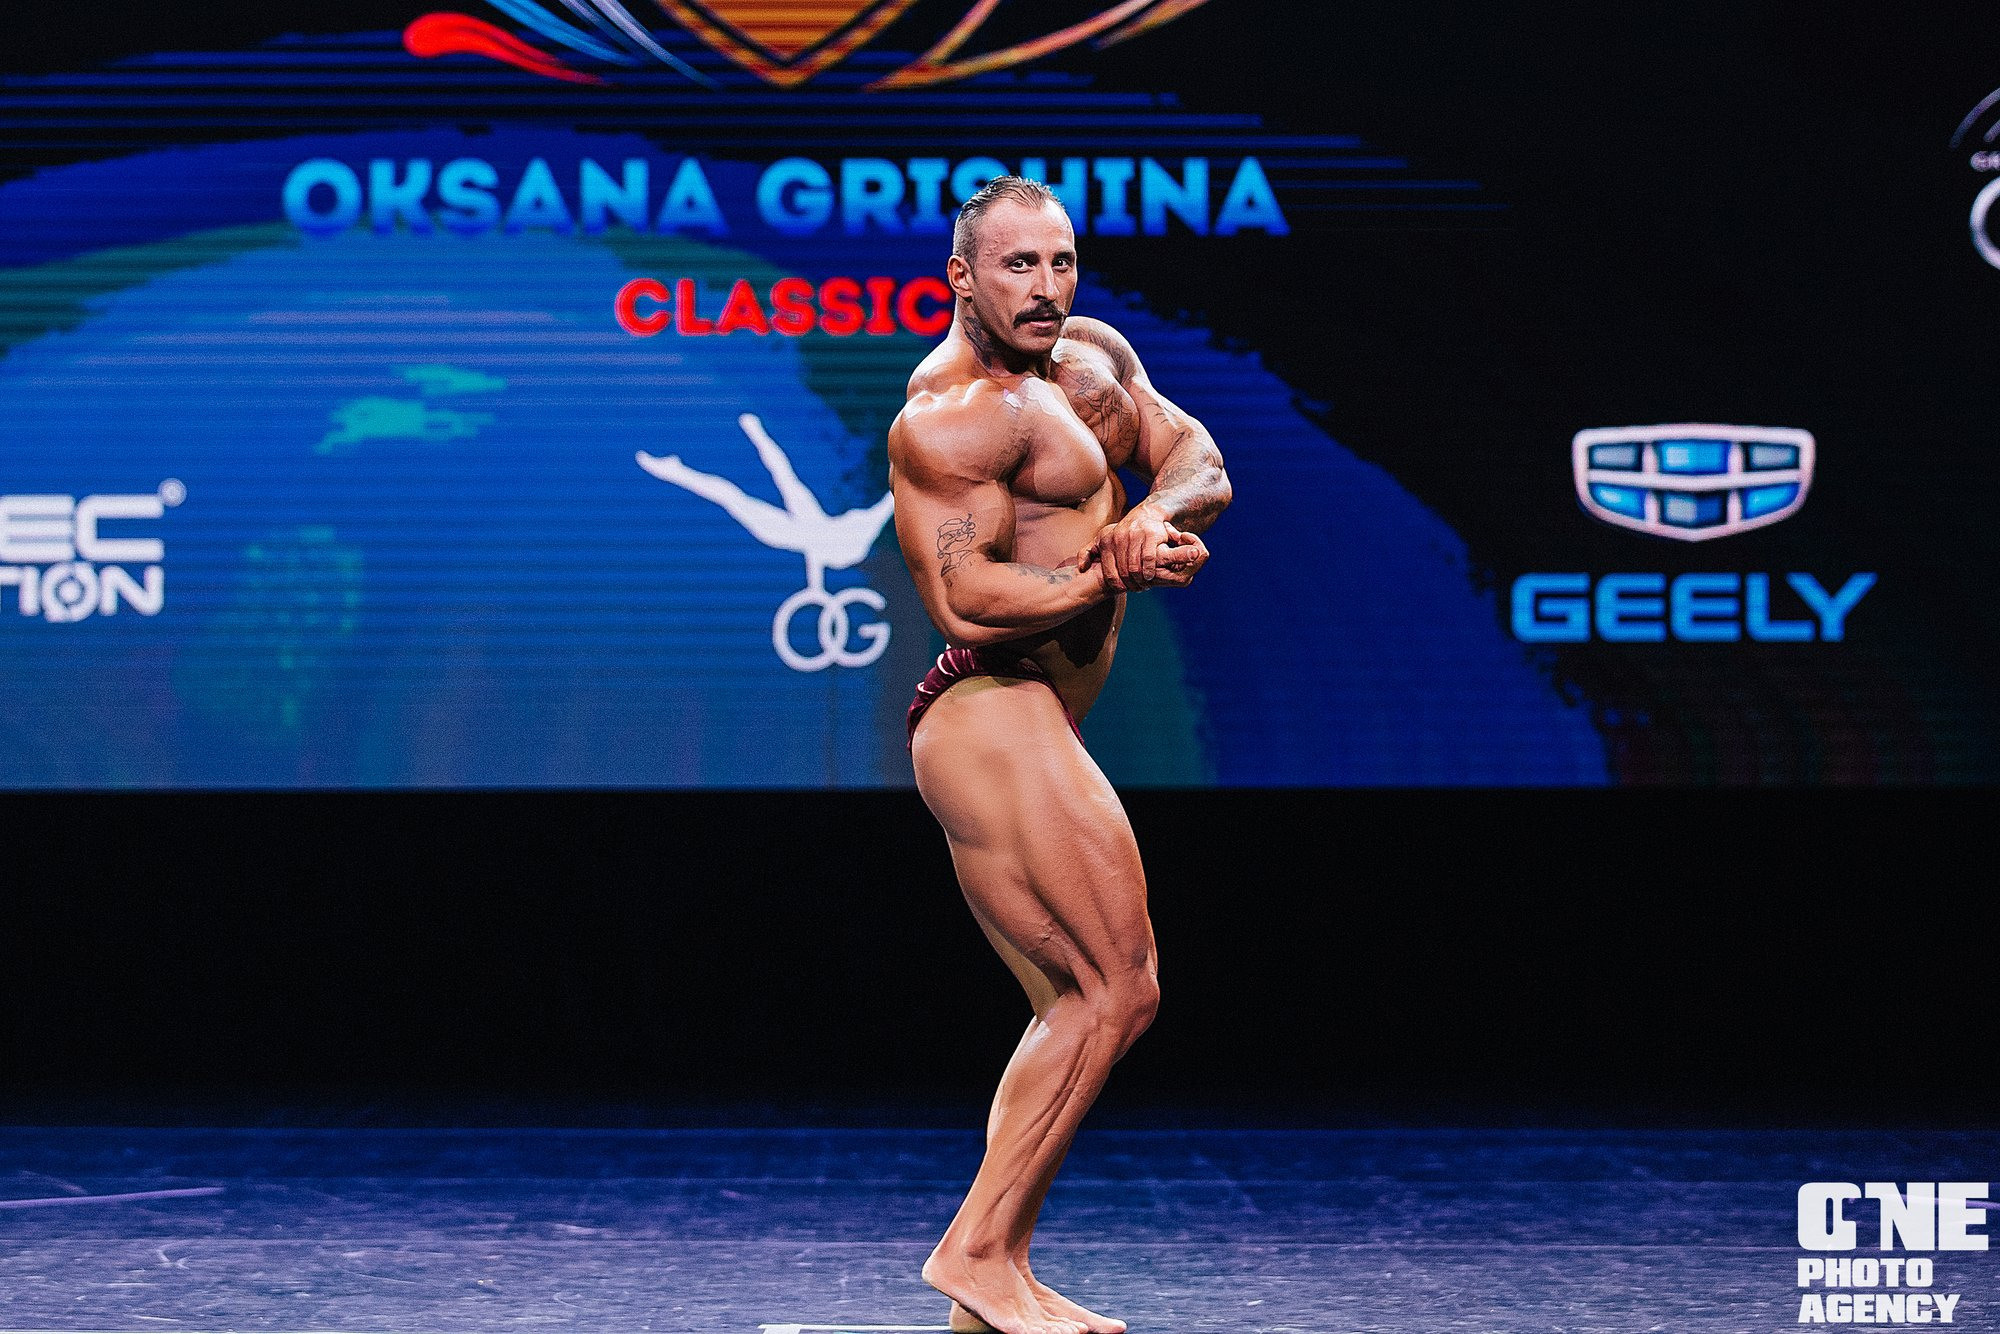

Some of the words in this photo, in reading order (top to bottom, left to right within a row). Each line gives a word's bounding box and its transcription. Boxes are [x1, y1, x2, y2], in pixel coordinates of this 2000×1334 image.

[282, 157, 730, 238] OKSANA
[614, 277, 950, 336] CLASSIC
[1511, 572, 1877, 643] GEELY
